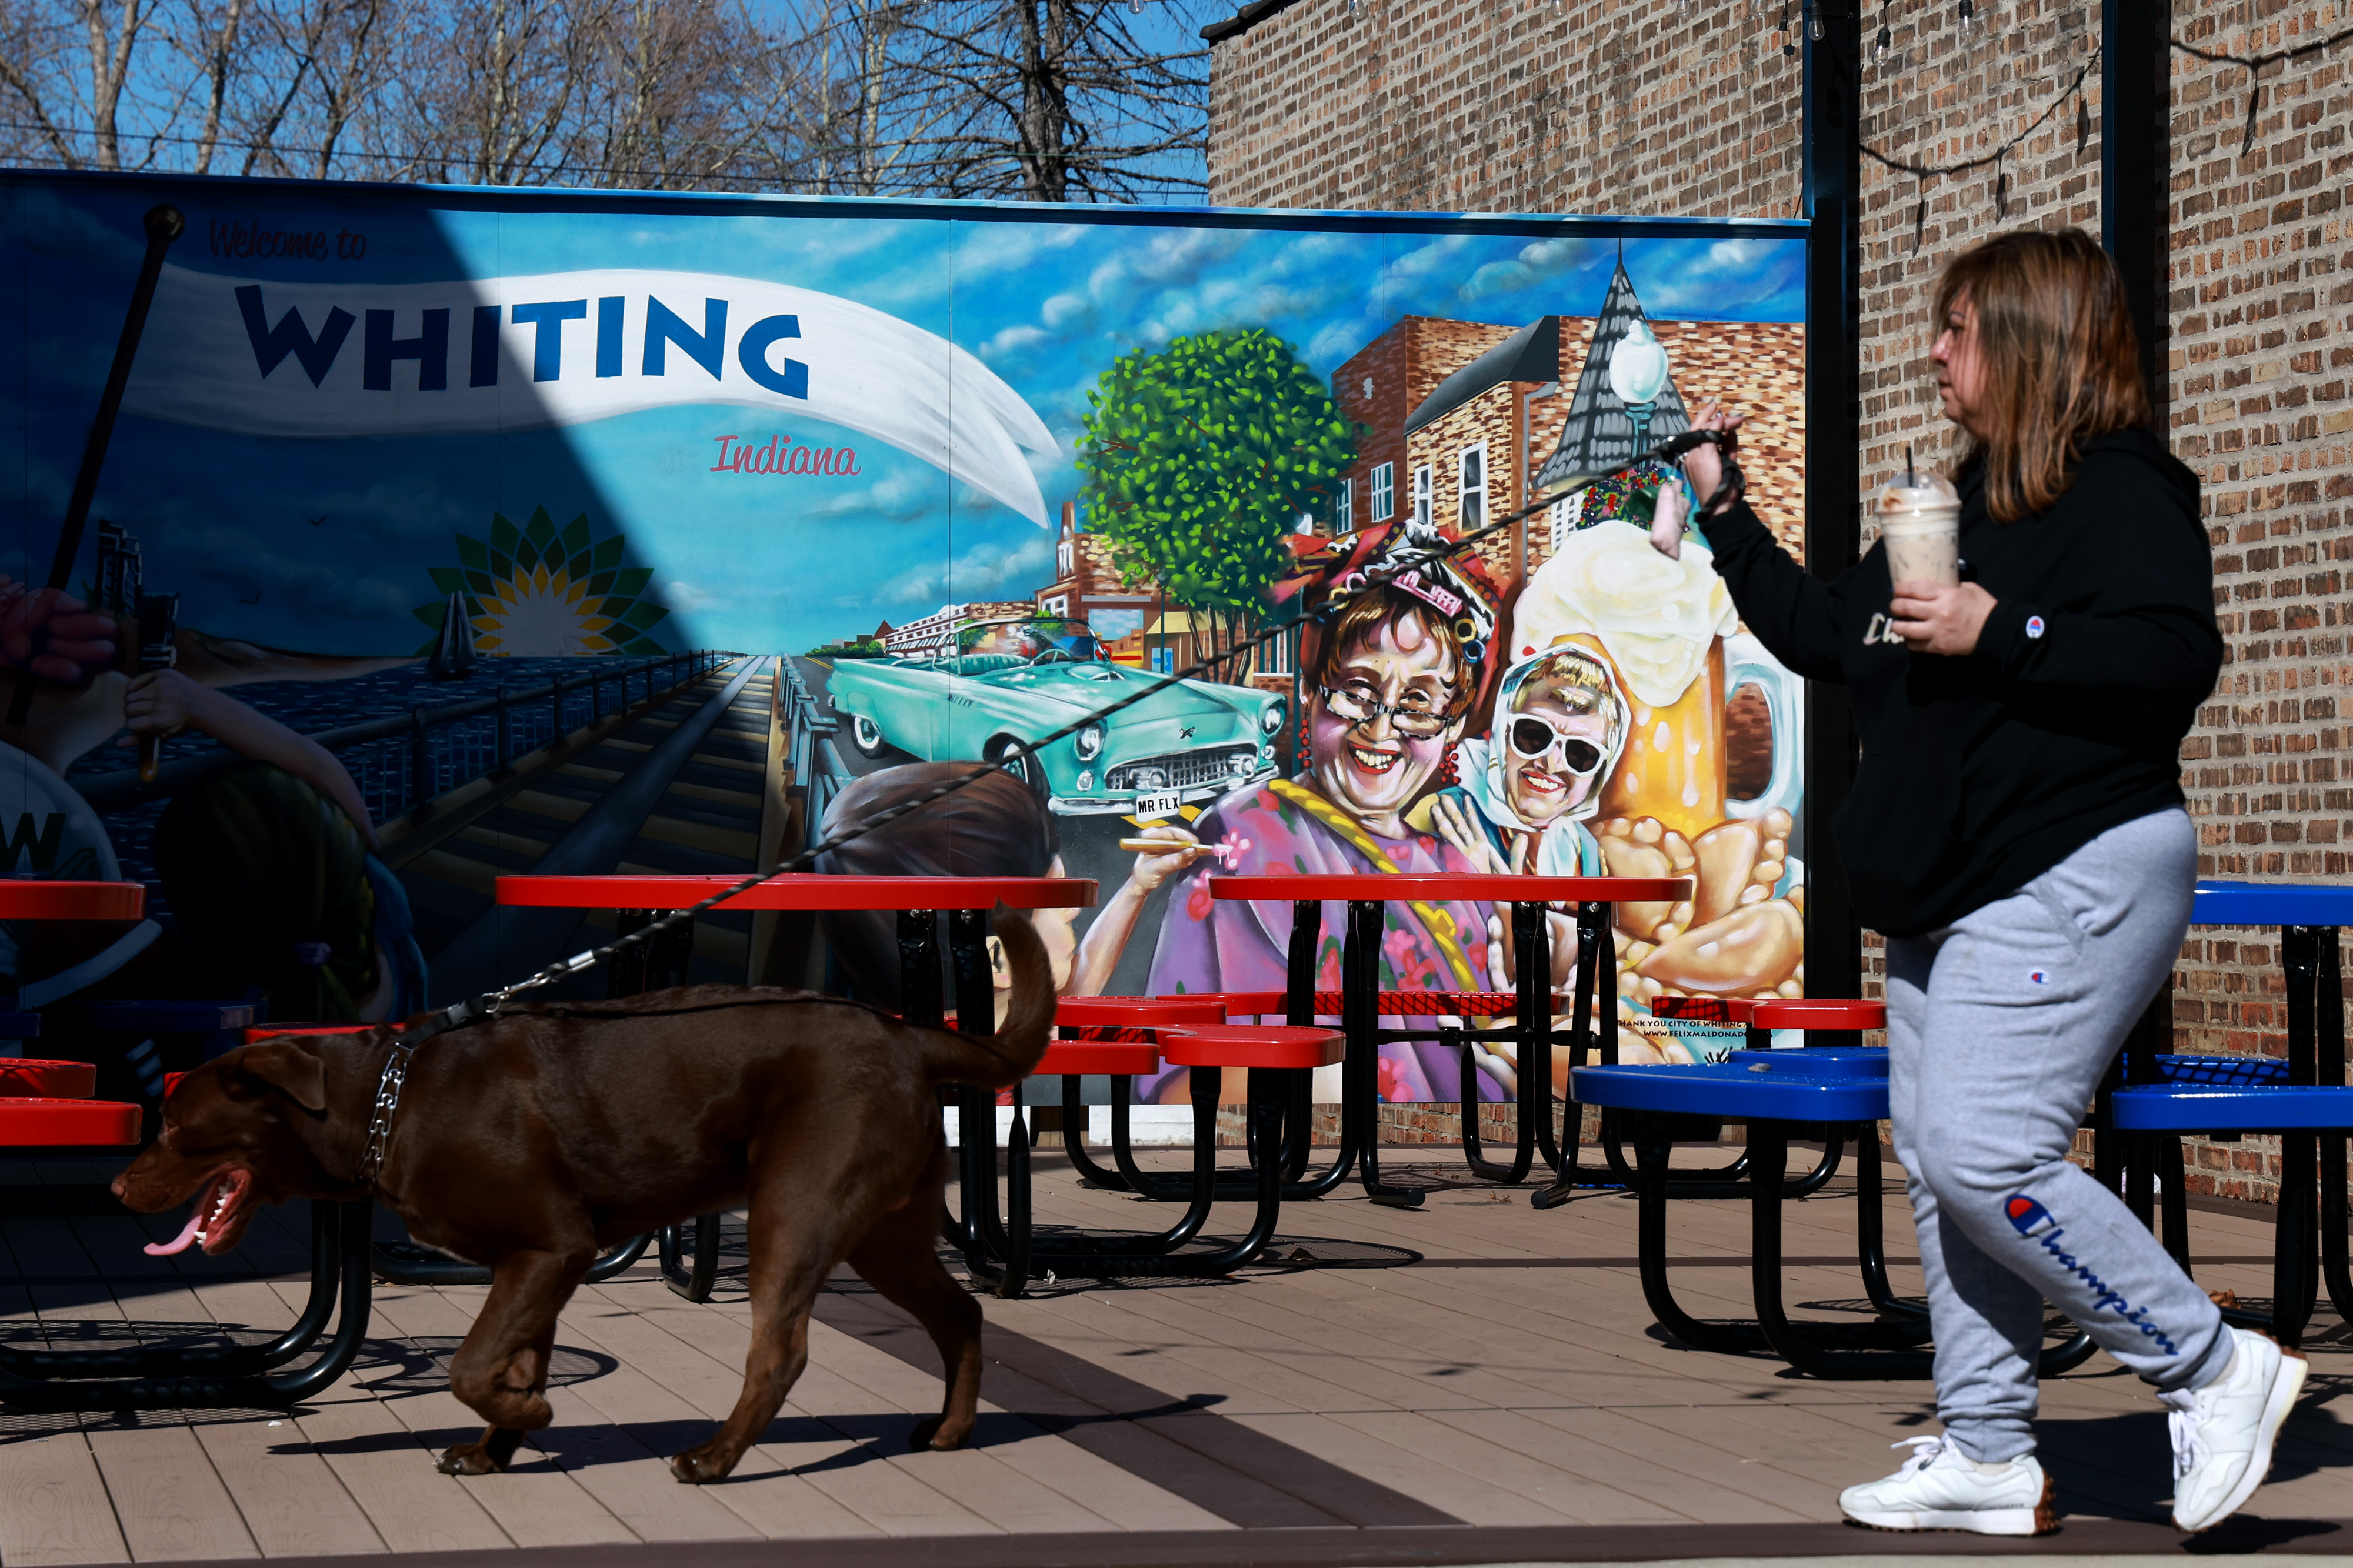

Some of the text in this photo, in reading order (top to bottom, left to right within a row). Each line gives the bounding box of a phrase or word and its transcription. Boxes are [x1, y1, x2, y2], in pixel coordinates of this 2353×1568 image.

[210, 219, 366, 261] Welcome to
[234, 285, 809, 400] WHITING
[709, 434, 861, 476] Indiana
[1138, 797, 1179, 813] MR FLX
[2005, 1194, 2178, 1355] Champion
